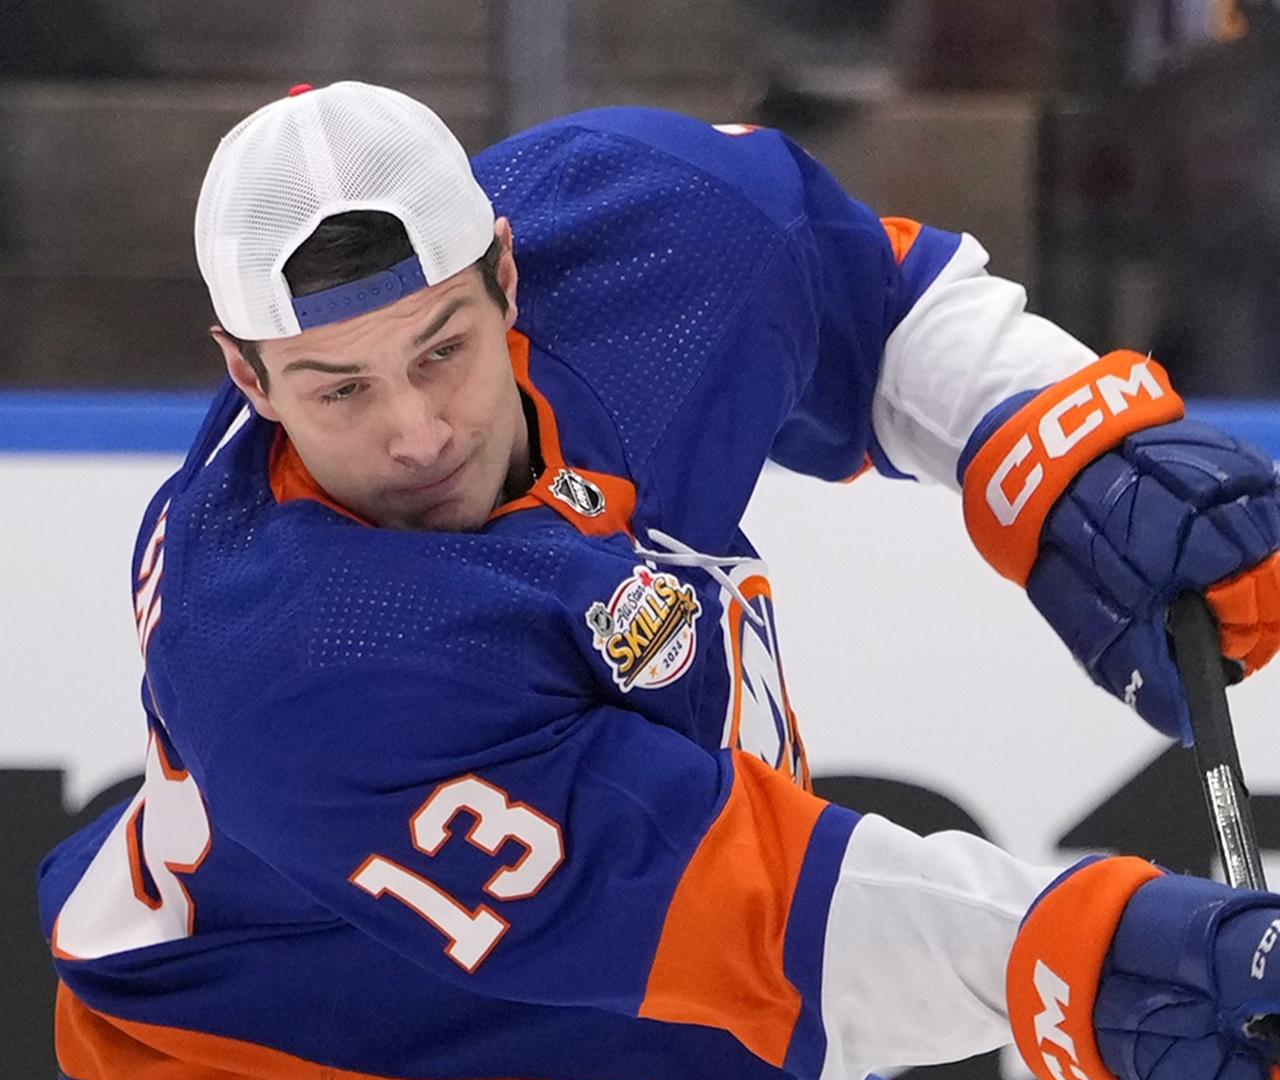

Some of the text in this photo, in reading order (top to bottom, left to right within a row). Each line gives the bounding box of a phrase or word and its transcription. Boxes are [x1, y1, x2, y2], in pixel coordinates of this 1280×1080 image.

[985, 363, 1164, 527] CCM
[606, 576, 677, 674] SKILLS
[662, 640, 683, 669] 2024
[347, 772, 566, 974] 13
